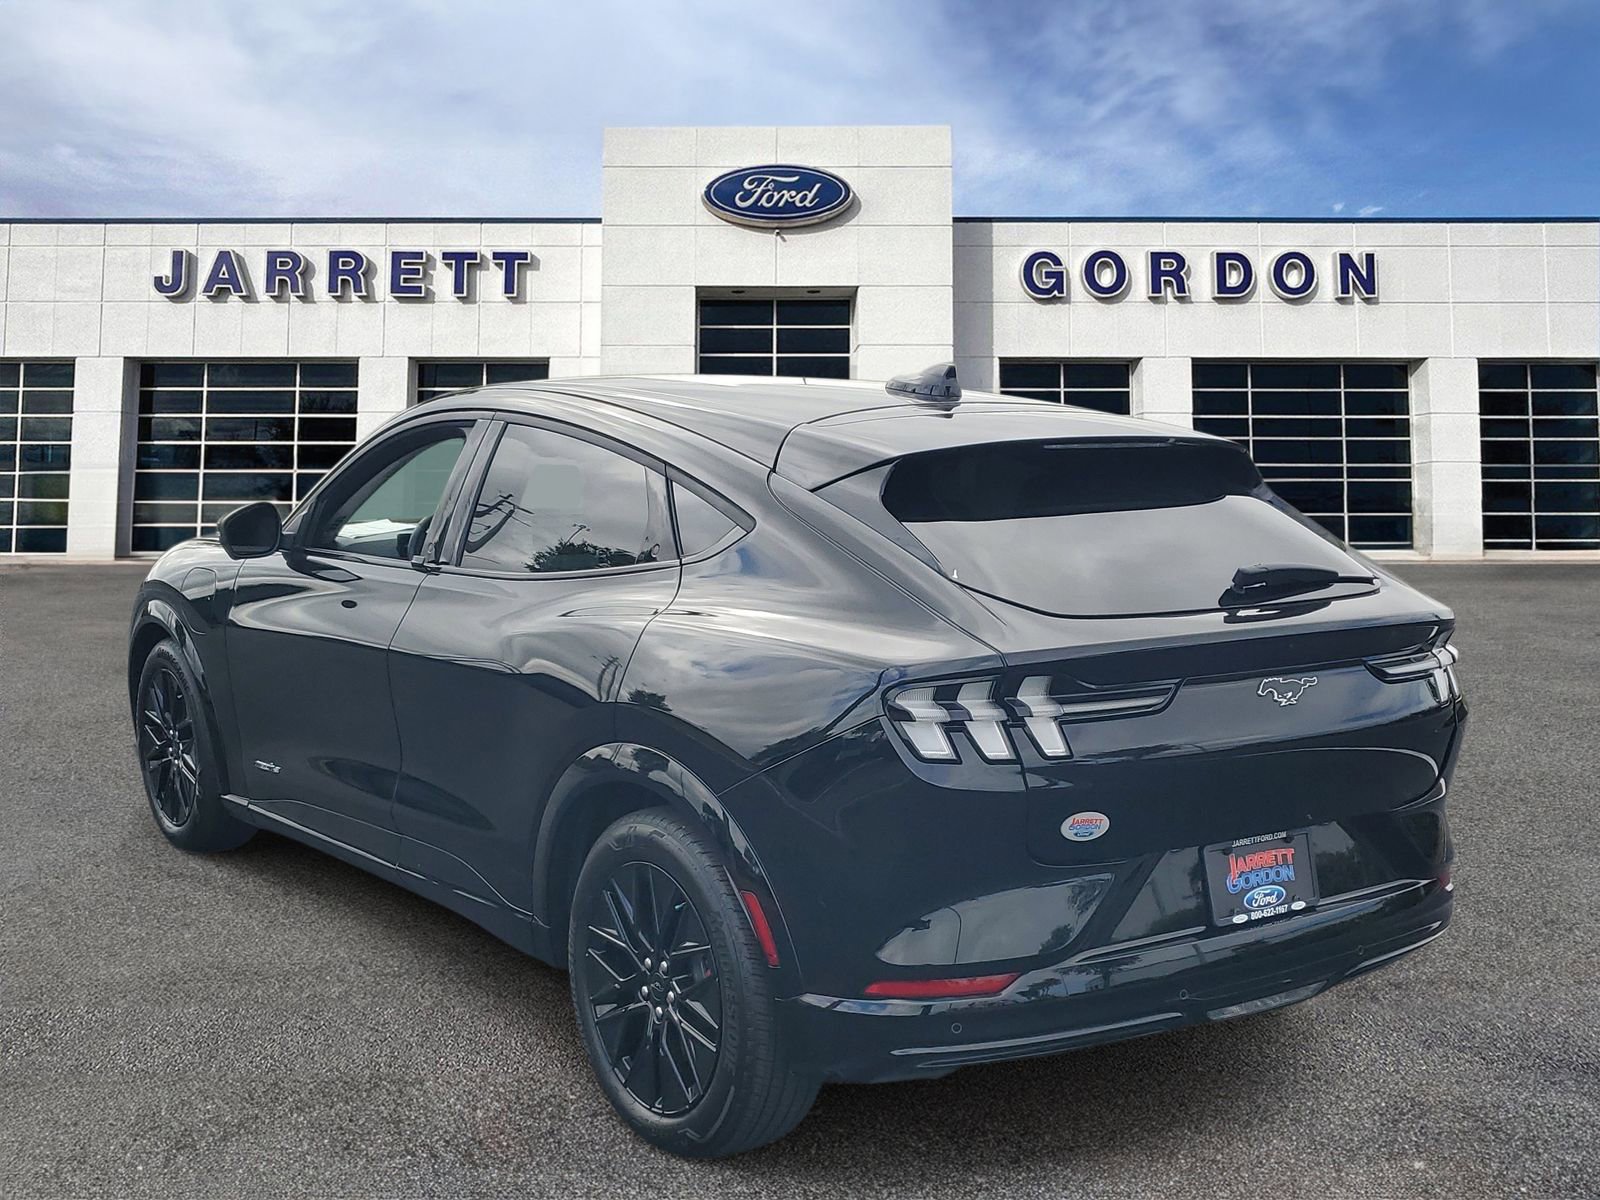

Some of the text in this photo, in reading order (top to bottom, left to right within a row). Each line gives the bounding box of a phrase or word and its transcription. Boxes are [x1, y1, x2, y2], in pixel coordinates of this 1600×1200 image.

[735, 174, 822, 208] Ford
[153, 248, 533, 299] JARRETT
[1020, 249, 1379, 300] GORDON
[1232, 831, 1287, 847] JARRETTFORD.COM
[1227, 865, 1295, 894] GORDON
[1229, 848, 1295, 885] JARRETT
[1252, 890, 1278, 907] Ford
